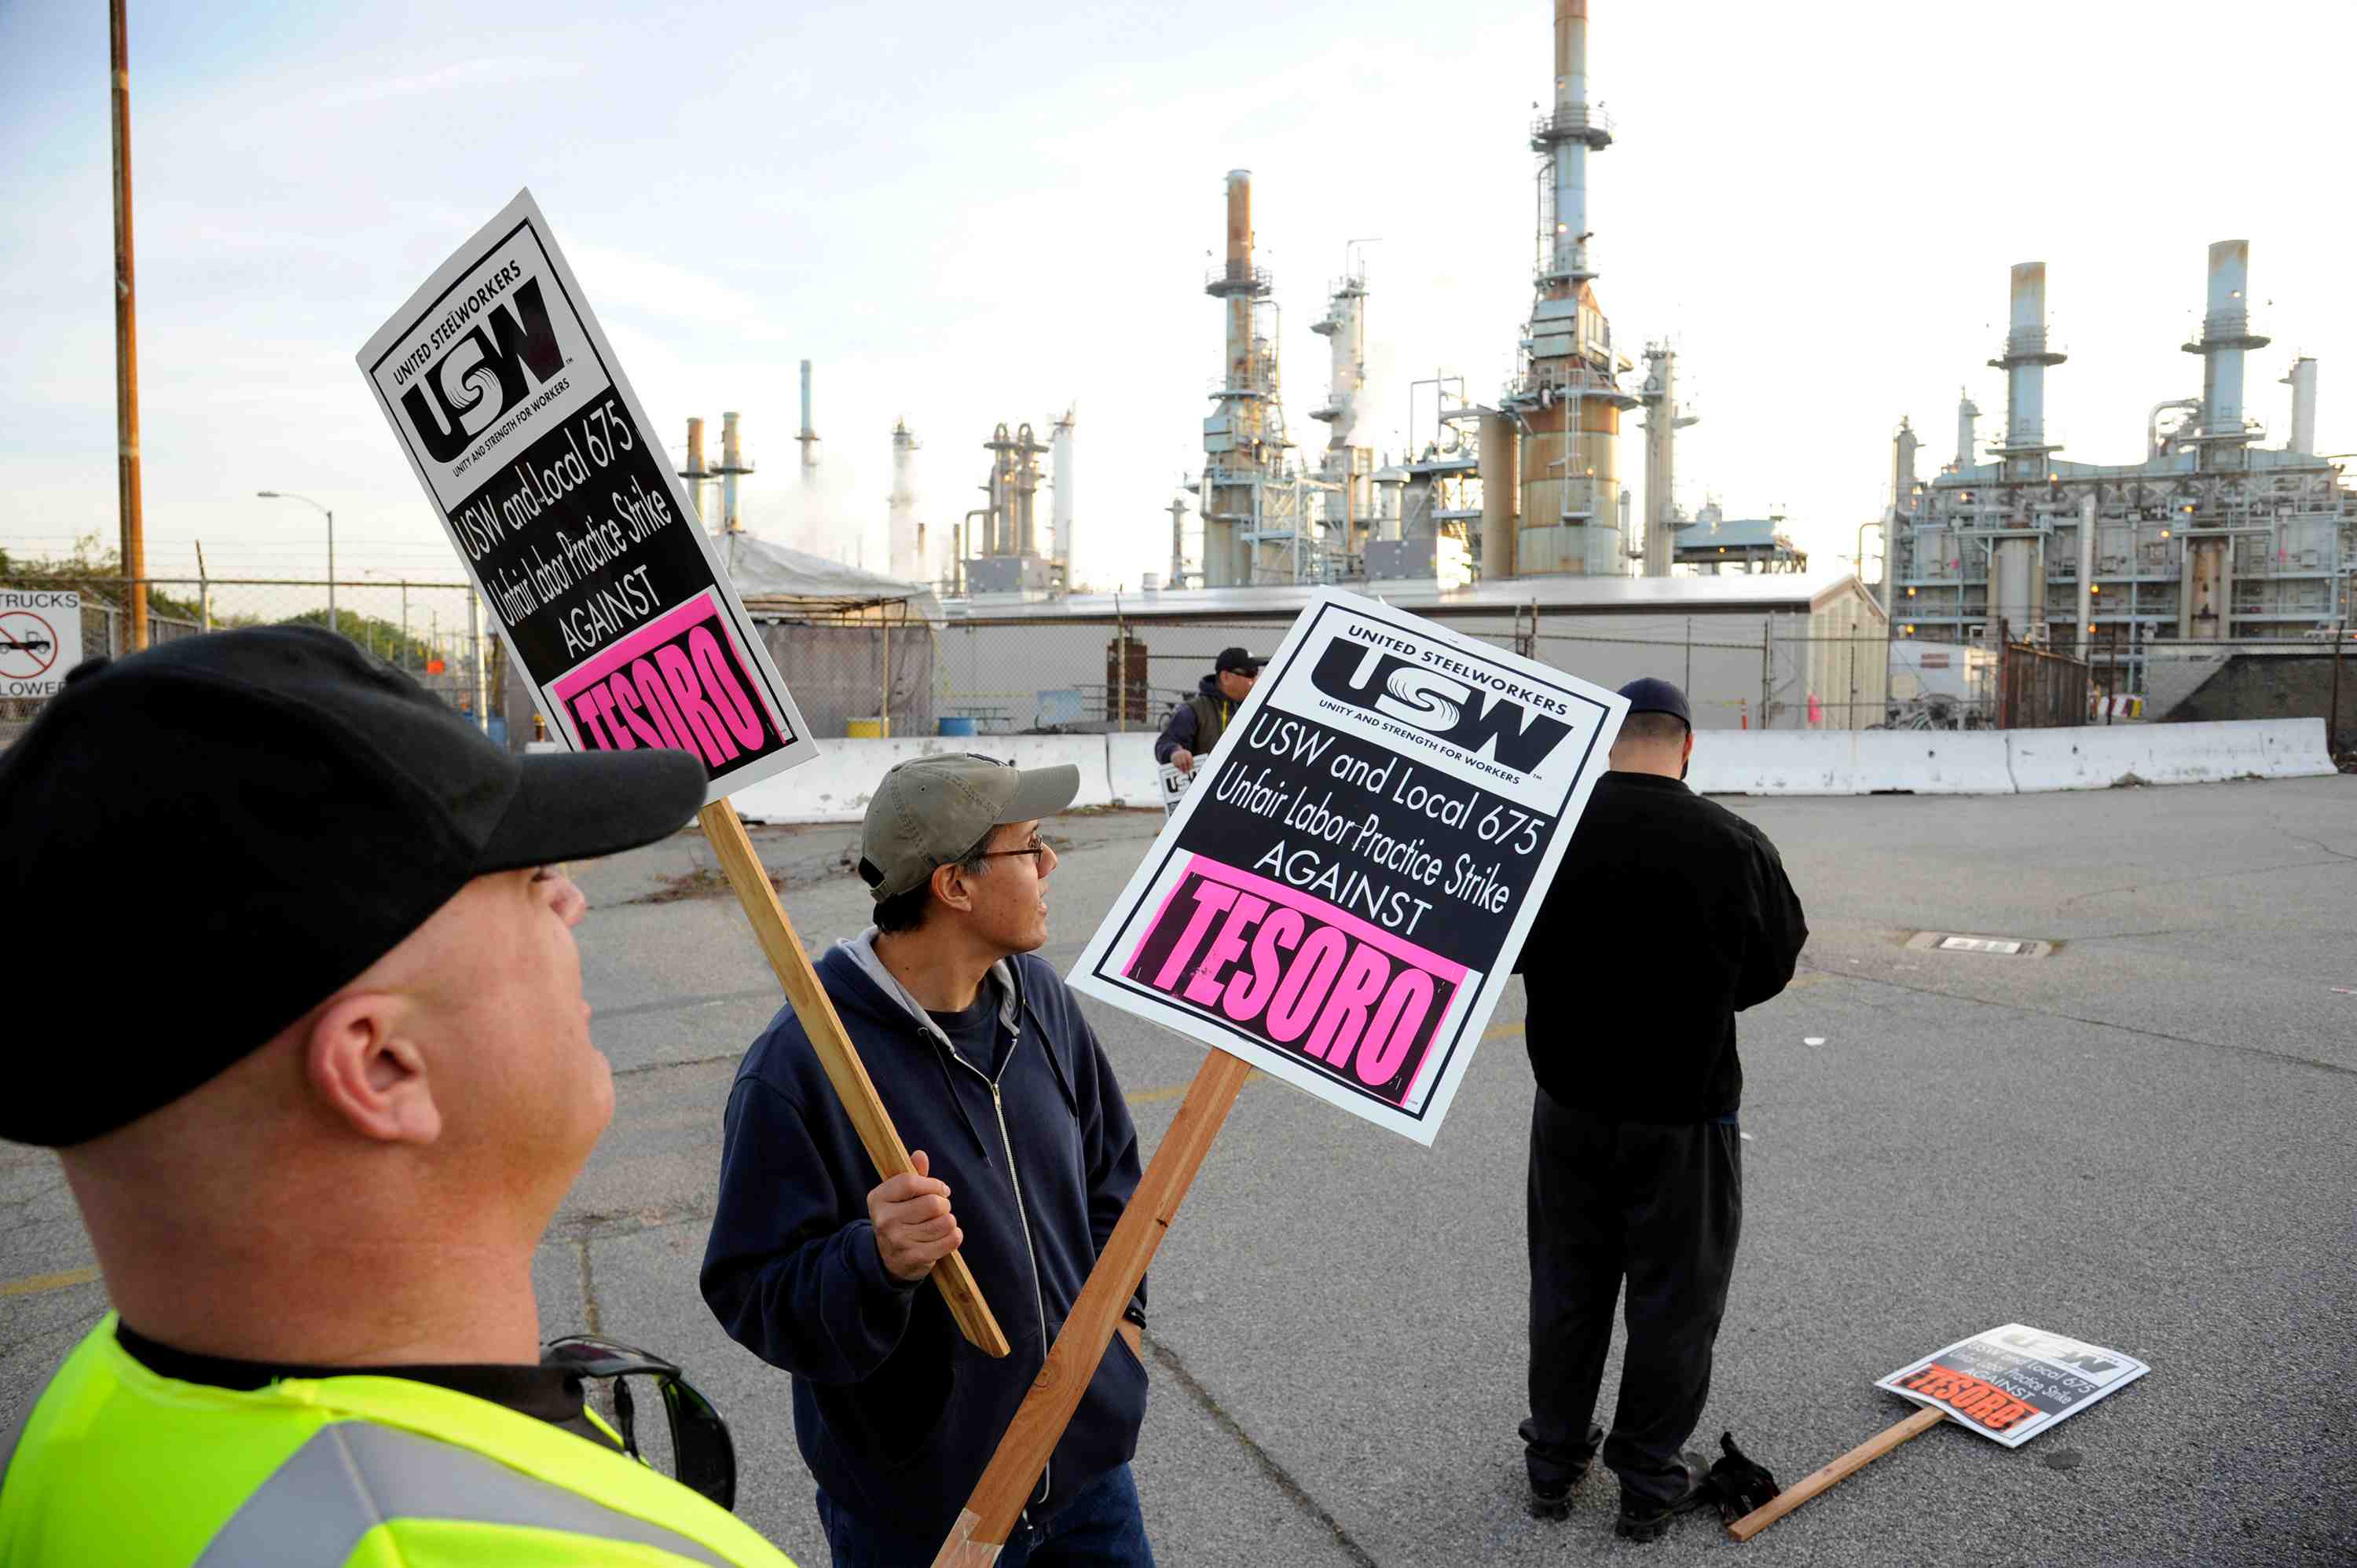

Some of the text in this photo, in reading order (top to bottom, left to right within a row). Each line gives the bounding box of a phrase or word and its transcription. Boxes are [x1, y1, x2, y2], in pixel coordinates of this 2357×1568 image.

[393, 259, 522, 386] UNITED STEELWORKERS
[401, 275, 566, 463] USW
[452, 377, 570, 478] UNITY AND STRENGTH FOR WORKERS
[453, 399, 633, 562] USW and Local 675
[487, 474, 672, 628] Unfair Labor Practice Strike
[559, 564, 661, 659] AGAINST
[1310, 636, 1574, 775] USW
[1348, 625, 1568, 716] UNITED STEELWORKERS
[1249, 712, 1546, 855] USW and Local 675
[1319, 698, 1521, 786] UNITY AND STRENGTH FOR WORKERS
[1215, 760, 1510, 914] Unfair Labor Practice Strike
[1252, 839, 1434, 936] AGAINST
[1152, 878, 1435, 1086] TESORO
[1908, 1370, 2025, 1430] TESORO
[1959, 1369, 2036, 1400] AGAINST
[2027, 1361, 2069, 1380] Local
[2062, 1377, 2096, 1394] 675
[2042, 1385, 2073, 1405] Strike
